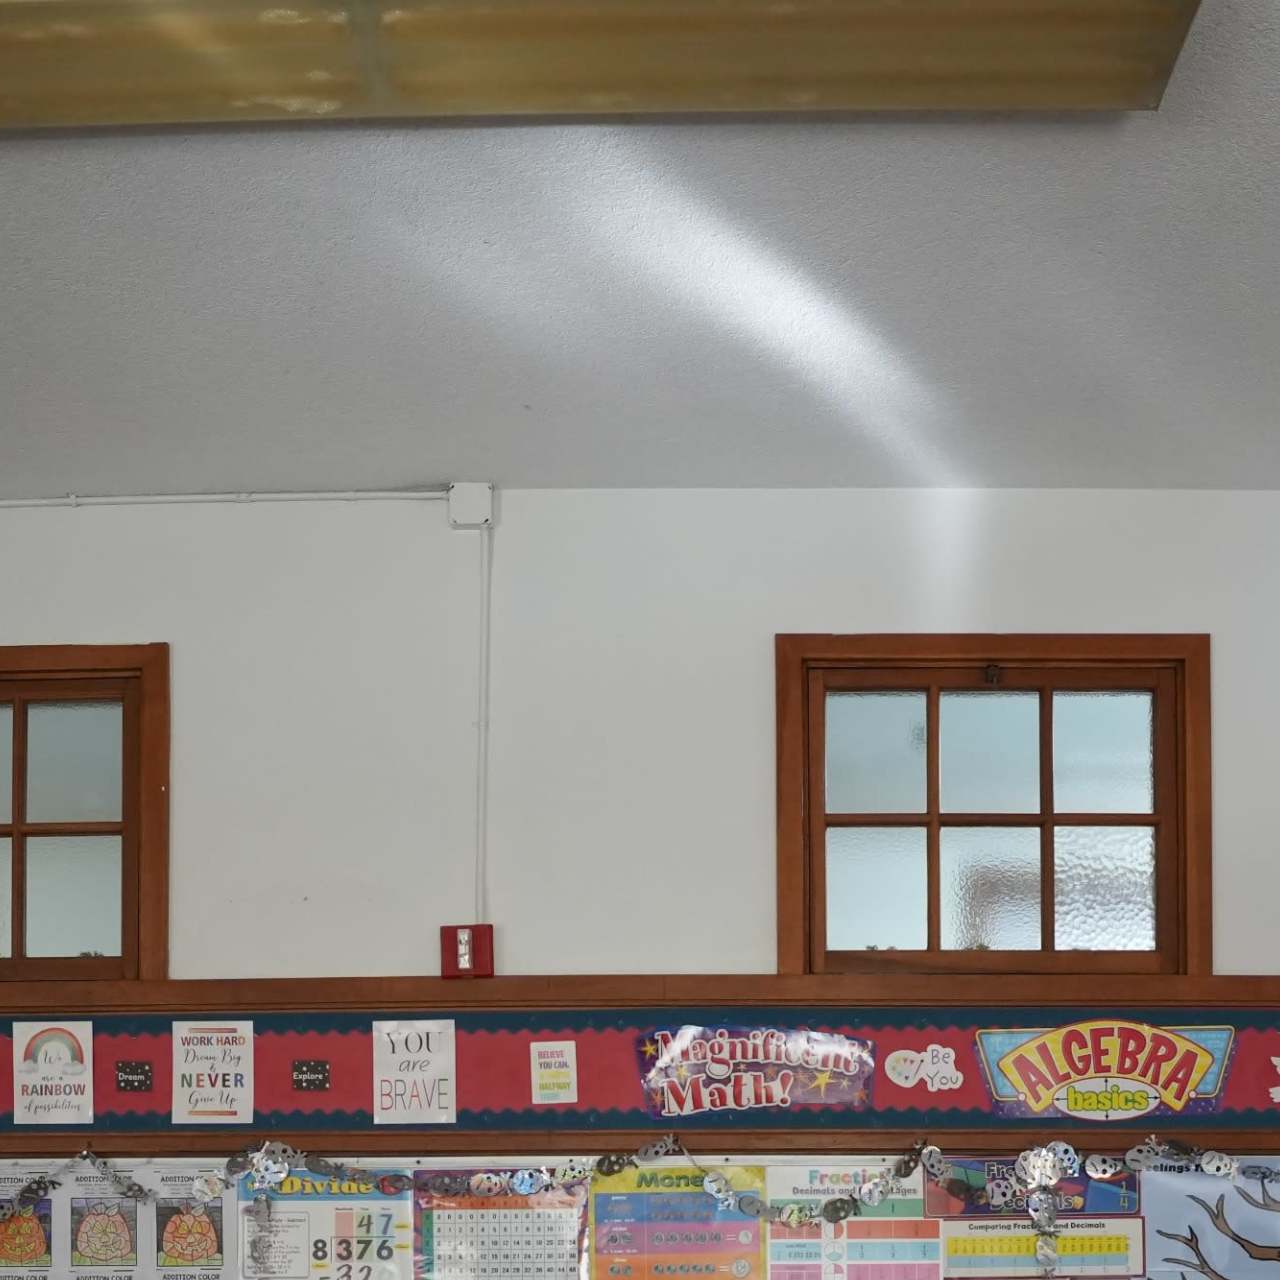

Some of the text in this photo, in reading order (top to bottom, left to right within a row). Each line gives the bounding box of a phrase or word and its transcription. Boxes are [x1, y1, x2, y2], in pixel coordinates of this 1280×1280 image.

[181, 1036, 246, 1047] WORK HARD
[386, 1031, 442, 1054] YOU
[184, 1048, 242, 1066] Dream Big
[655, 1028, 860, 1078] Magnificent
[930, 1048, 951, 1065] Be
[398, 1058, 431, 1073] are
[1011, 1026, 1199, 1105] ALGEBRA
[118, 1072, 145, 1081] Dream
[181, 1073, 245, 1088] NEVER
[293, 1071, 324, 1082] Explore
[928, 1071, 959, 1087] You
[21, 1083, 86, 1096] RAINBOW
[380, 1078, 449, 1111] BRAVE
[661, 1069, 794, 1116] Math!
[1066, 1084, 1149, 1112] basics
[188, 1090, 238, 1108] Give Up
[278, 1177, 372, 1195] Divide
[637, 1172, 706, 1189] Mone
[792, 1186, 835, 1195] Decimals
[839, 1186, 856, 1195] and
[968, 1223, 1012, 1232] Comparing
[1070, 1221, 1106, 1229] Decimals
[313, 1239, 394, 1261] 8 376
